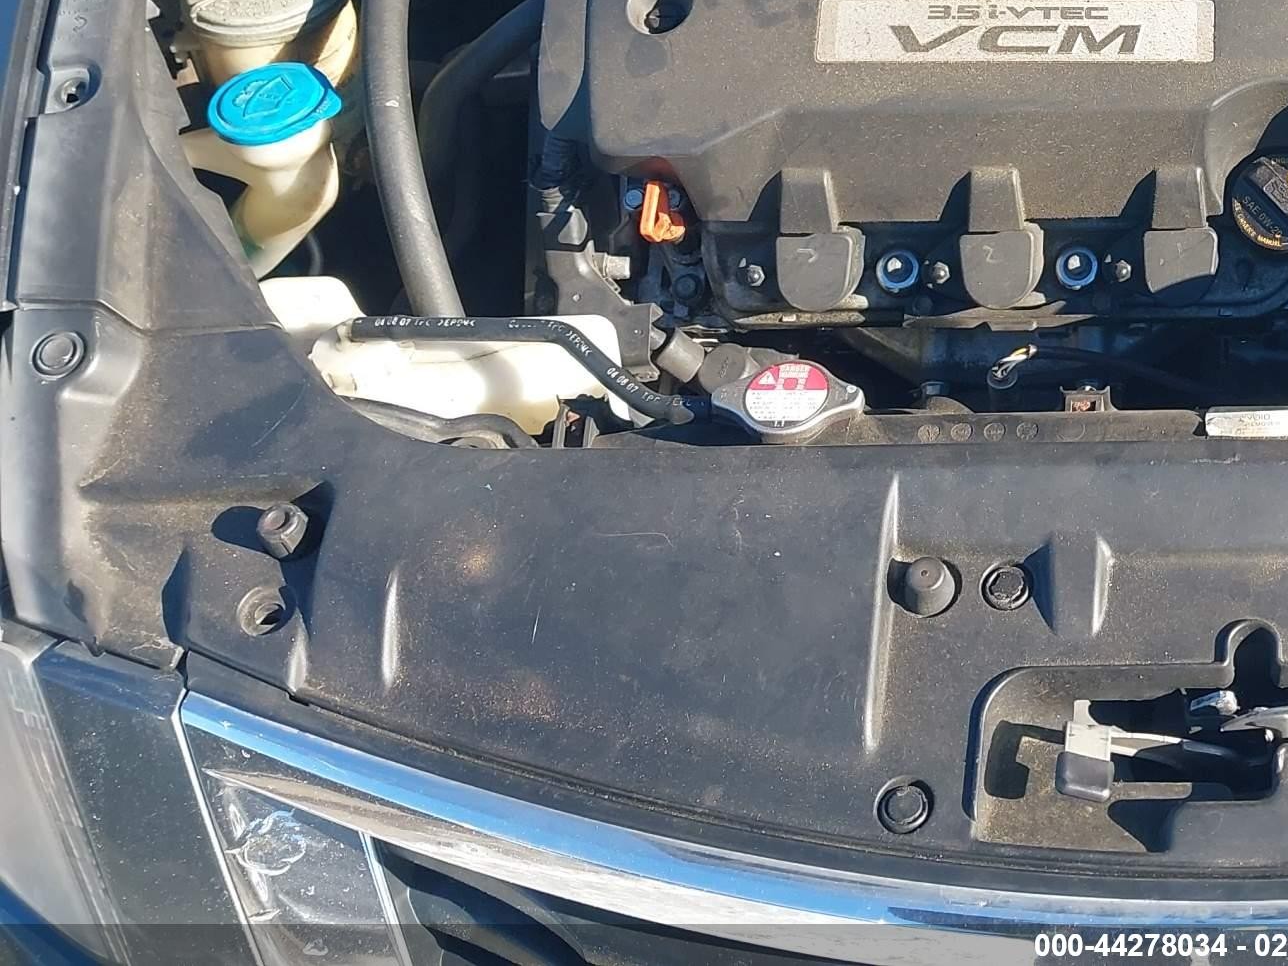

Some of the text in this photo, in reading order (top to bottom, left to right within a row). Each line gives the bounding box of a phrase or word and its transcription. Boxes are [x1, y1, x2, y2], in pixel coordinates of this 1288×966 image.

[927, 4, 979, 20] 3.5
[888, 24, 1142, 54] VCM
[1242, 195, 1260, 214] SAE
